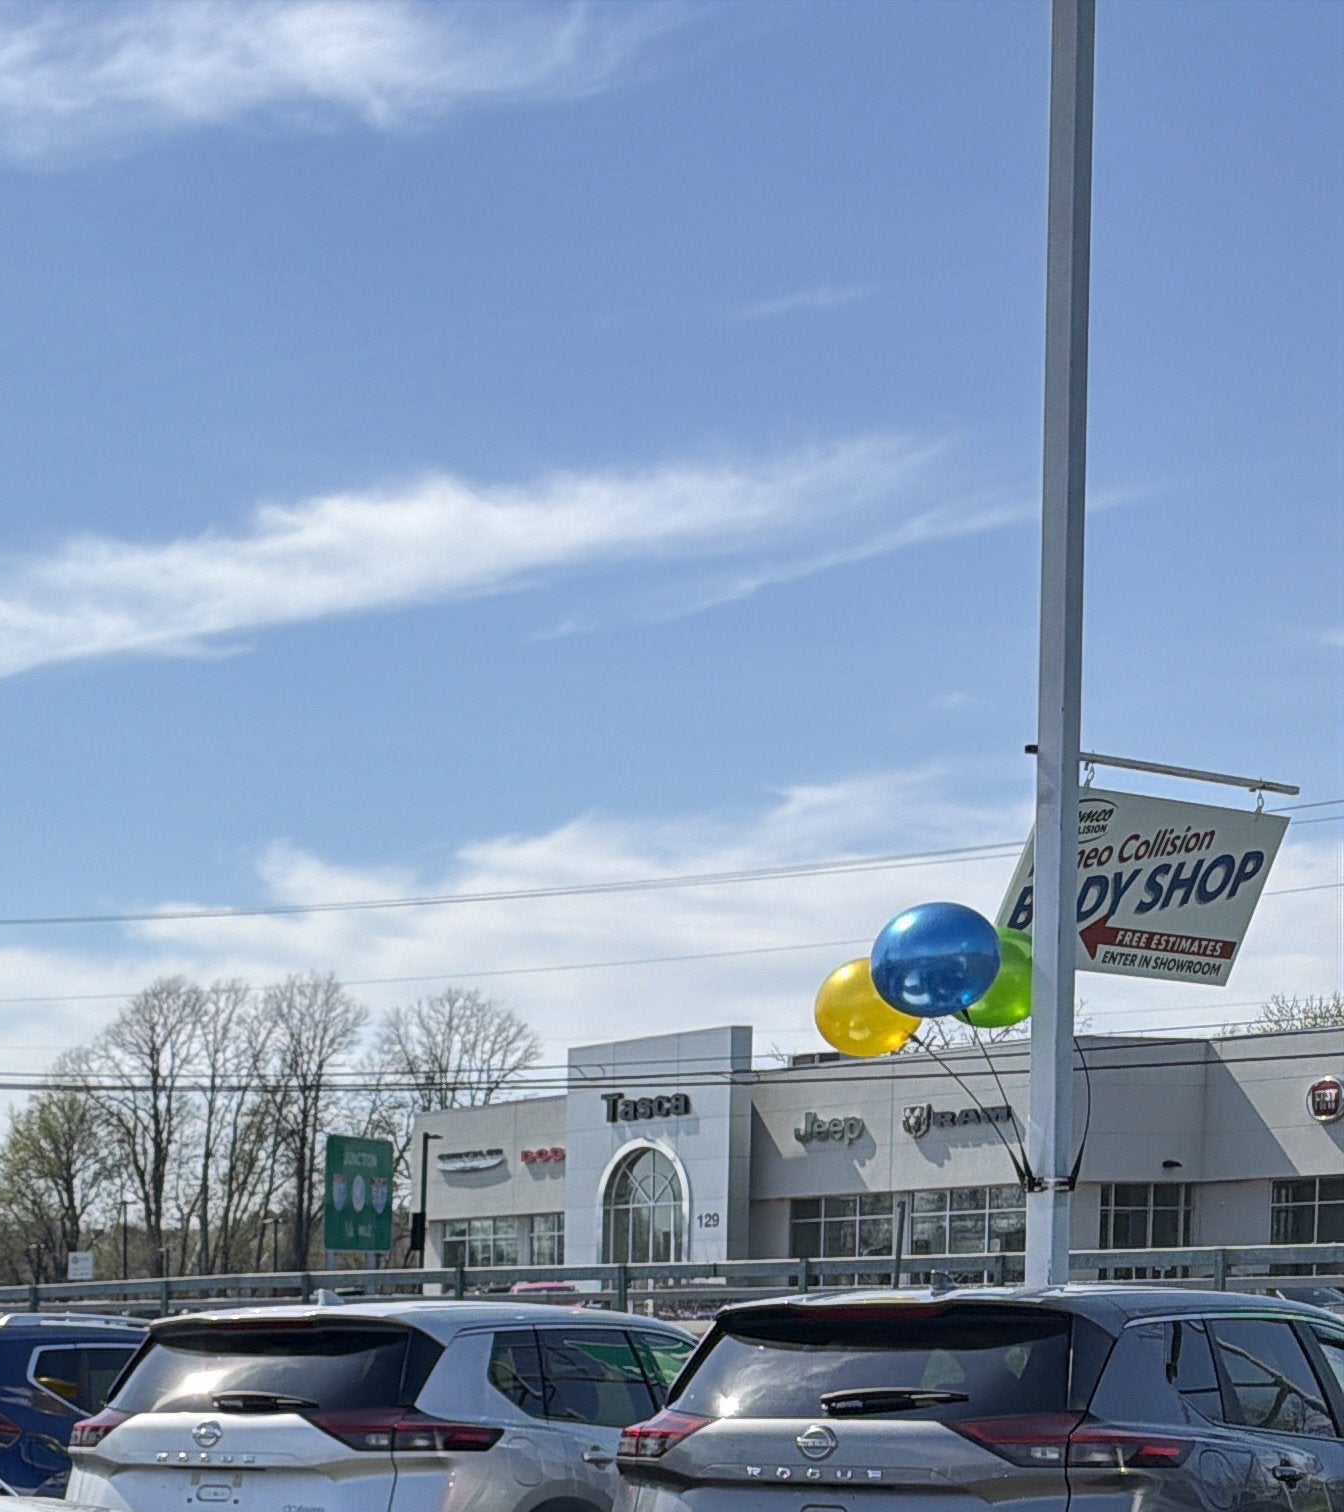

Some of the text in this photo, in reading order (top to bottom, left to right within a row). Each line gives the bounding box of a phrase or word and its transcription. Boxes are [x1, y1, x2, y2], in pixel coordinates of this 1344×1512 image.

[1117, 825, 1216, 864] Collision
[1007, 850, 1266, 931] BDY SHOP
[1114, 930, 1224, 957] FREE ESTIMATES
[1101, 950, 1223, 977] ENTER IN SHOWROOM
[601, 1093, 690, 1123] Tasca
[933, 1105, 1012, 1128] RAM
[794, 1111, 866, 1145] Jeep
[697, 1212, 720, 1228] 129
